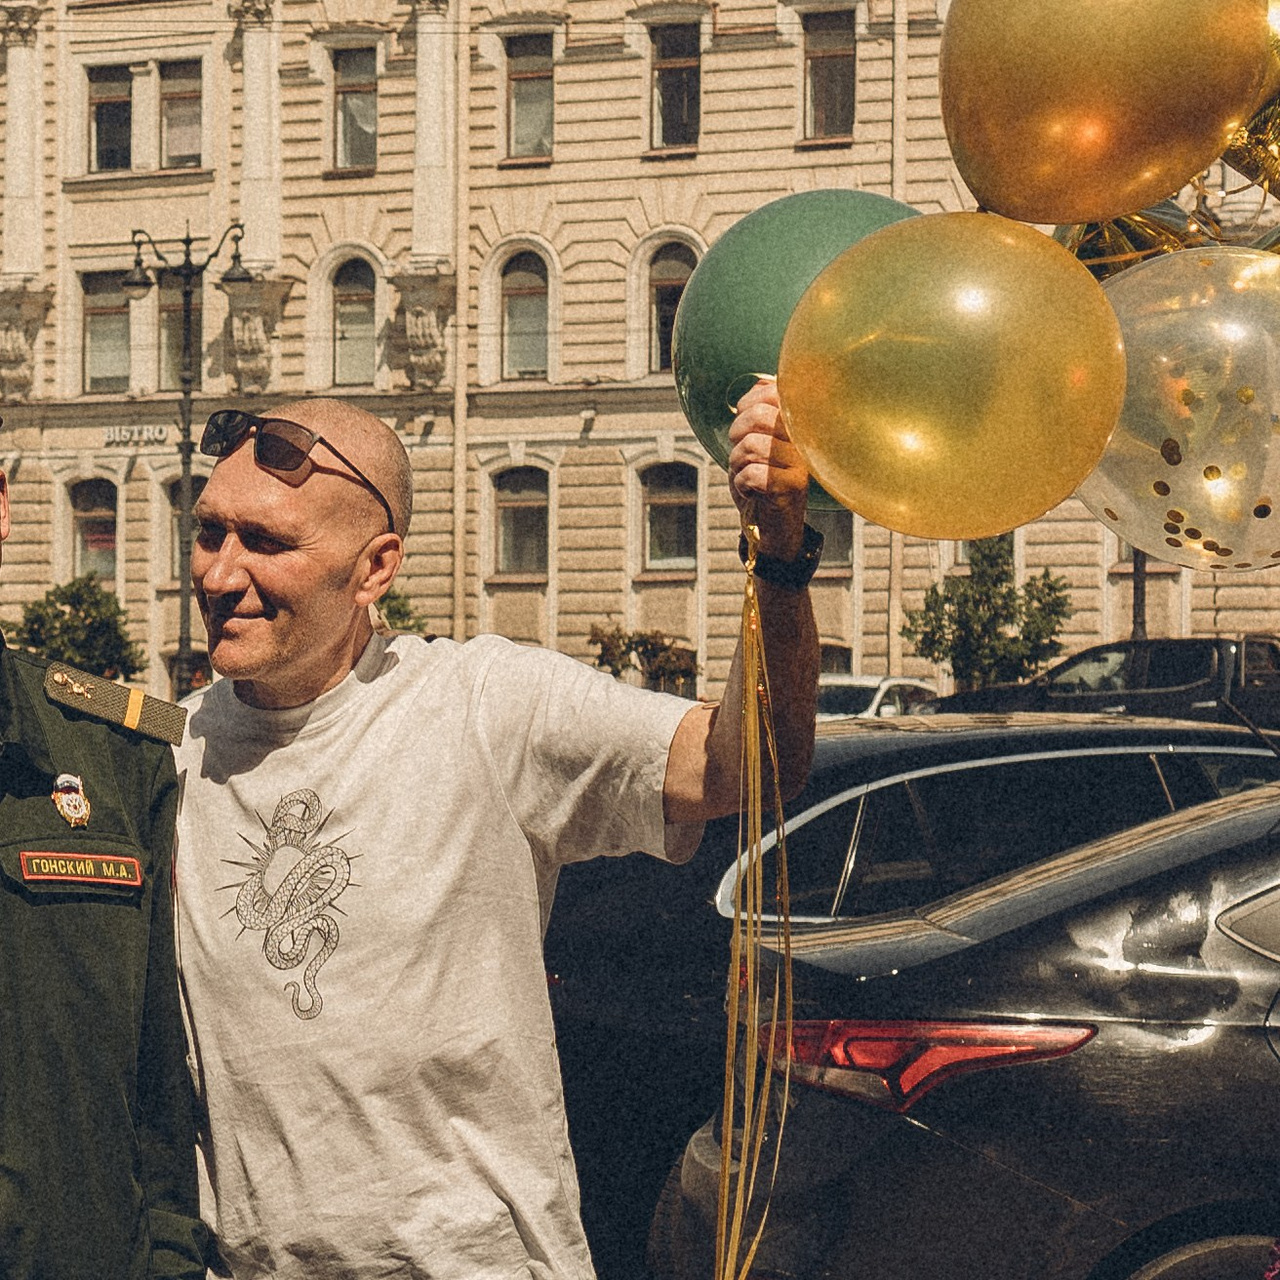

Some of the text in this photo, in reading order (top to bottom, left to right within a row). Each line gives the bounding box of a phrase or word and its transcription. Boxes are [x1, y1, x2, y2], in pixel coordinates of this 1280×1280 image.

[103, 425, 168, 442] BISTRO
[32, 858, 133, 879] ГОНСКИЙ М.А.
